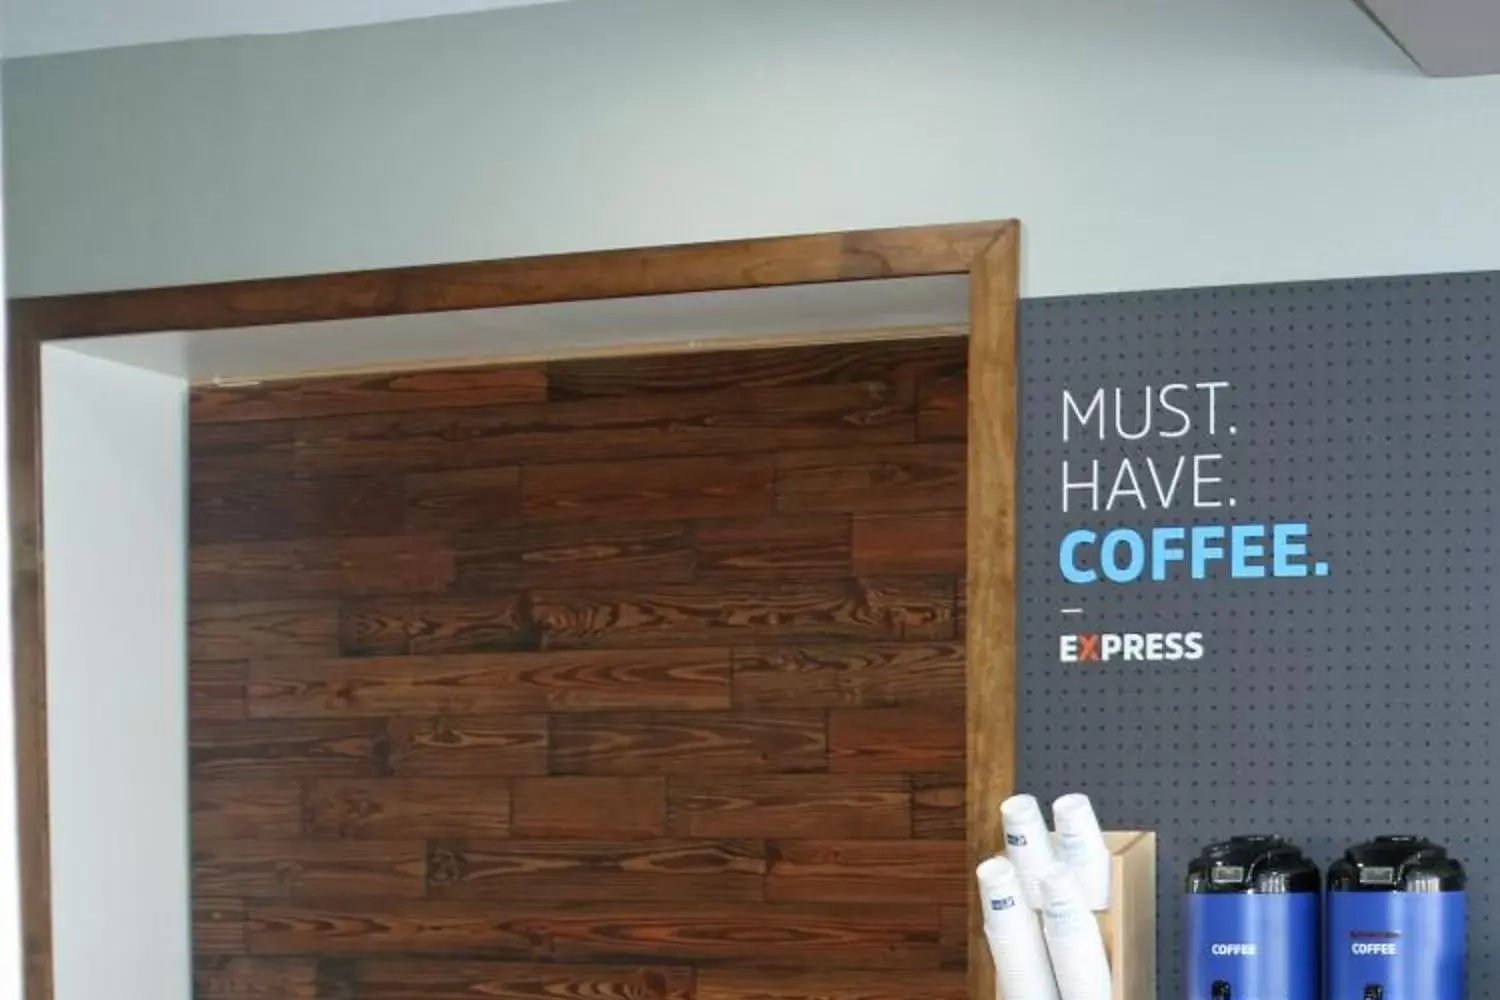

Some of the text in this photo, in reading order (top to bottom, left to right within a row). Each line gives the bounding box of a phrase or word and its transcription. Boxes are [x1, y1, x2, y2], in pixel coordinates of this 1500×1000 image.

[1062, 381, 1238, 443] MUST.
[1062, 453, 1237, 513] HAVE.
[1058, 522, 1330, 584] COFFEE.
[1059, 631, 1205, 663] EXPRESS
[1210, 942, 1258, 957] COFFEE
[1350, 941, 1398, 957] COFFEE
